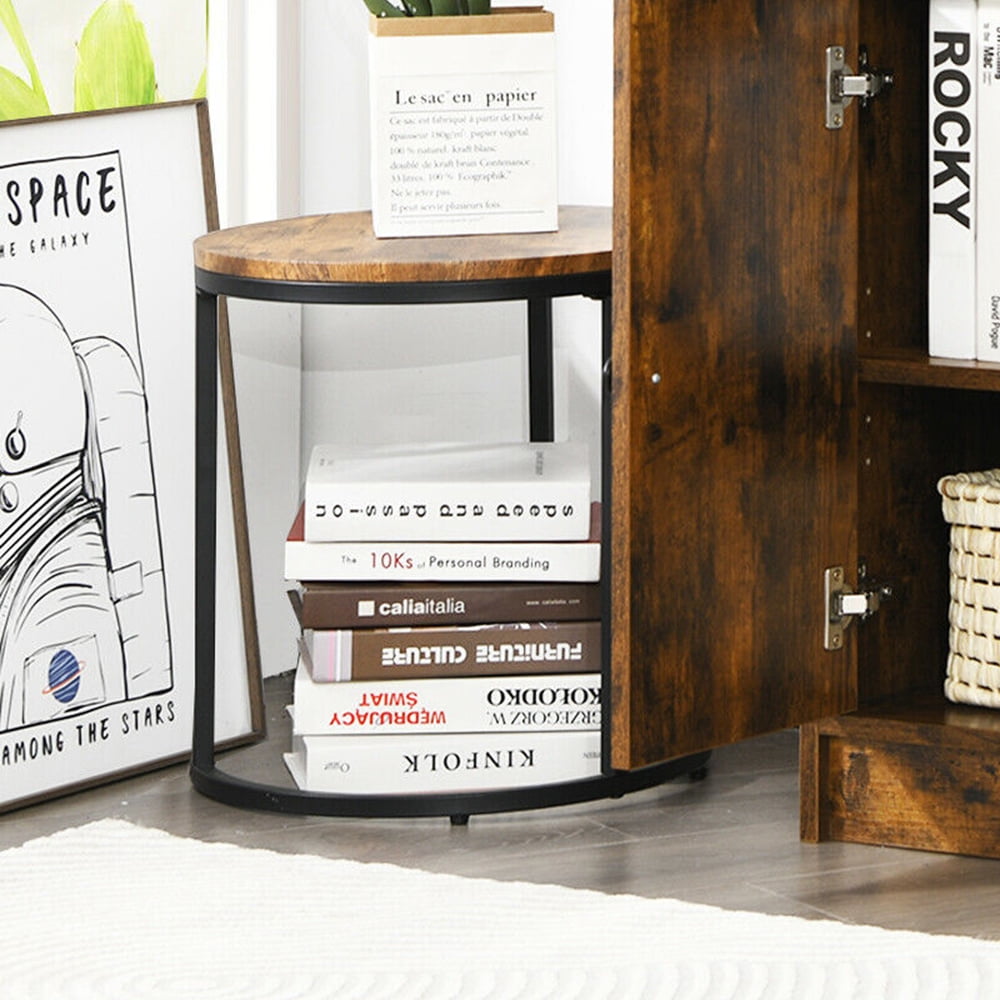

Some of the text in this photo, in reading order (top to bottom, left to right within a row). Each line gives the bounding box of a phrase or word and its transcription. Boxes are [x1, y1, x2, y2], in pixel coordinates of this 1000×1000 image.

[983, 46, 994, 69] Mac
[395, 89, 418, 106] Le
[452, 93, 472, 104] en
[486, 87, 538, 108] papier
[933, 30, 972, 230] ROCKY
[7, 166, 116, 226] SPACE
[30, 232, 90, 254] GALAXY
[989, 295, 1000, 350] David Pogue
[315, 503, 574, 518] speed and passion
[371, 552, 414, 569] 10Ks
[429, 555, 487, 569] Personal
[493, 555, 550, 571] Branding
[382, 645, 467, 666] CULTURE
[358, 692, 419, 709] ŚWIAT
[486, 687, 602, 707] KOŁODKO
[329, 708, 447, 726] WĘDRUJĄCY
[2, 701, 176, 766] AMONG THE STARS
[403, 749, 535, 774] KINFOLK
